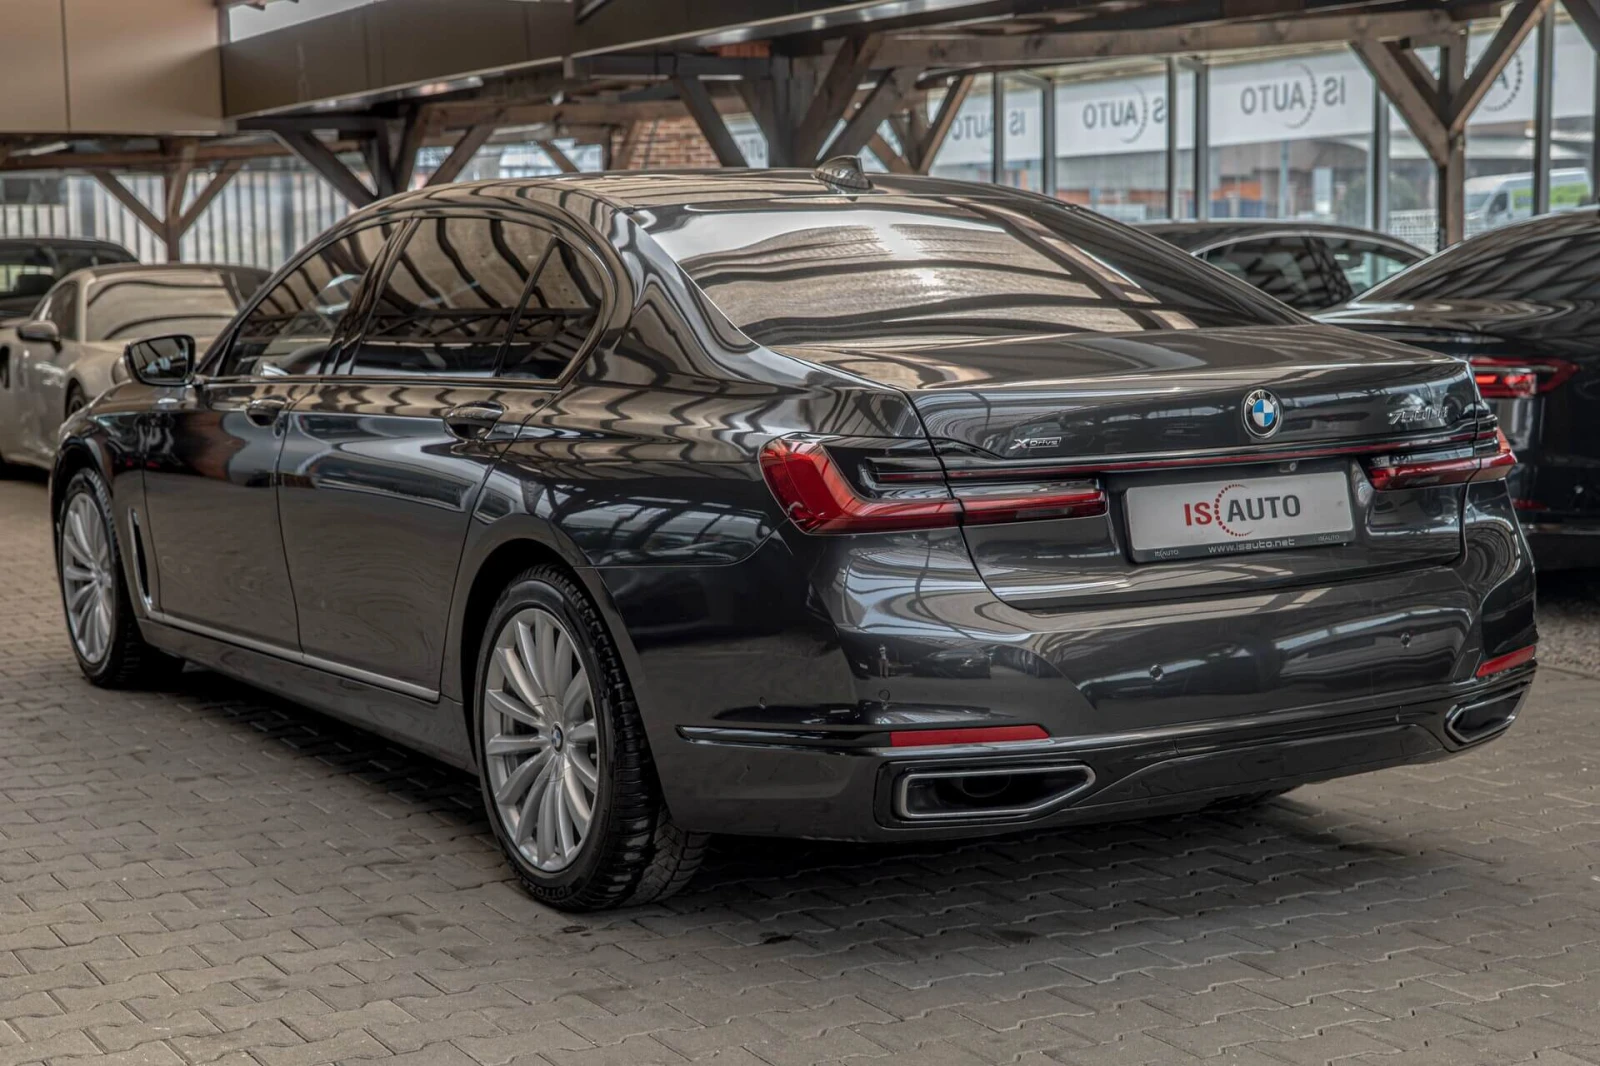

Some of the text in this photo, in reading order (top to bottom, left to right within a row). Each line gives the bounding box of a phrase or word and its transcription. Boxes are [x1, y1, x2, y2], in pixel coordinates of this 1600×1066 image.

[1247, 391, 1277, 405] BMW
[1184, 494, 1301, 527] IS AUTO
[1208, 538, 1296, 554] www.isauto.net
